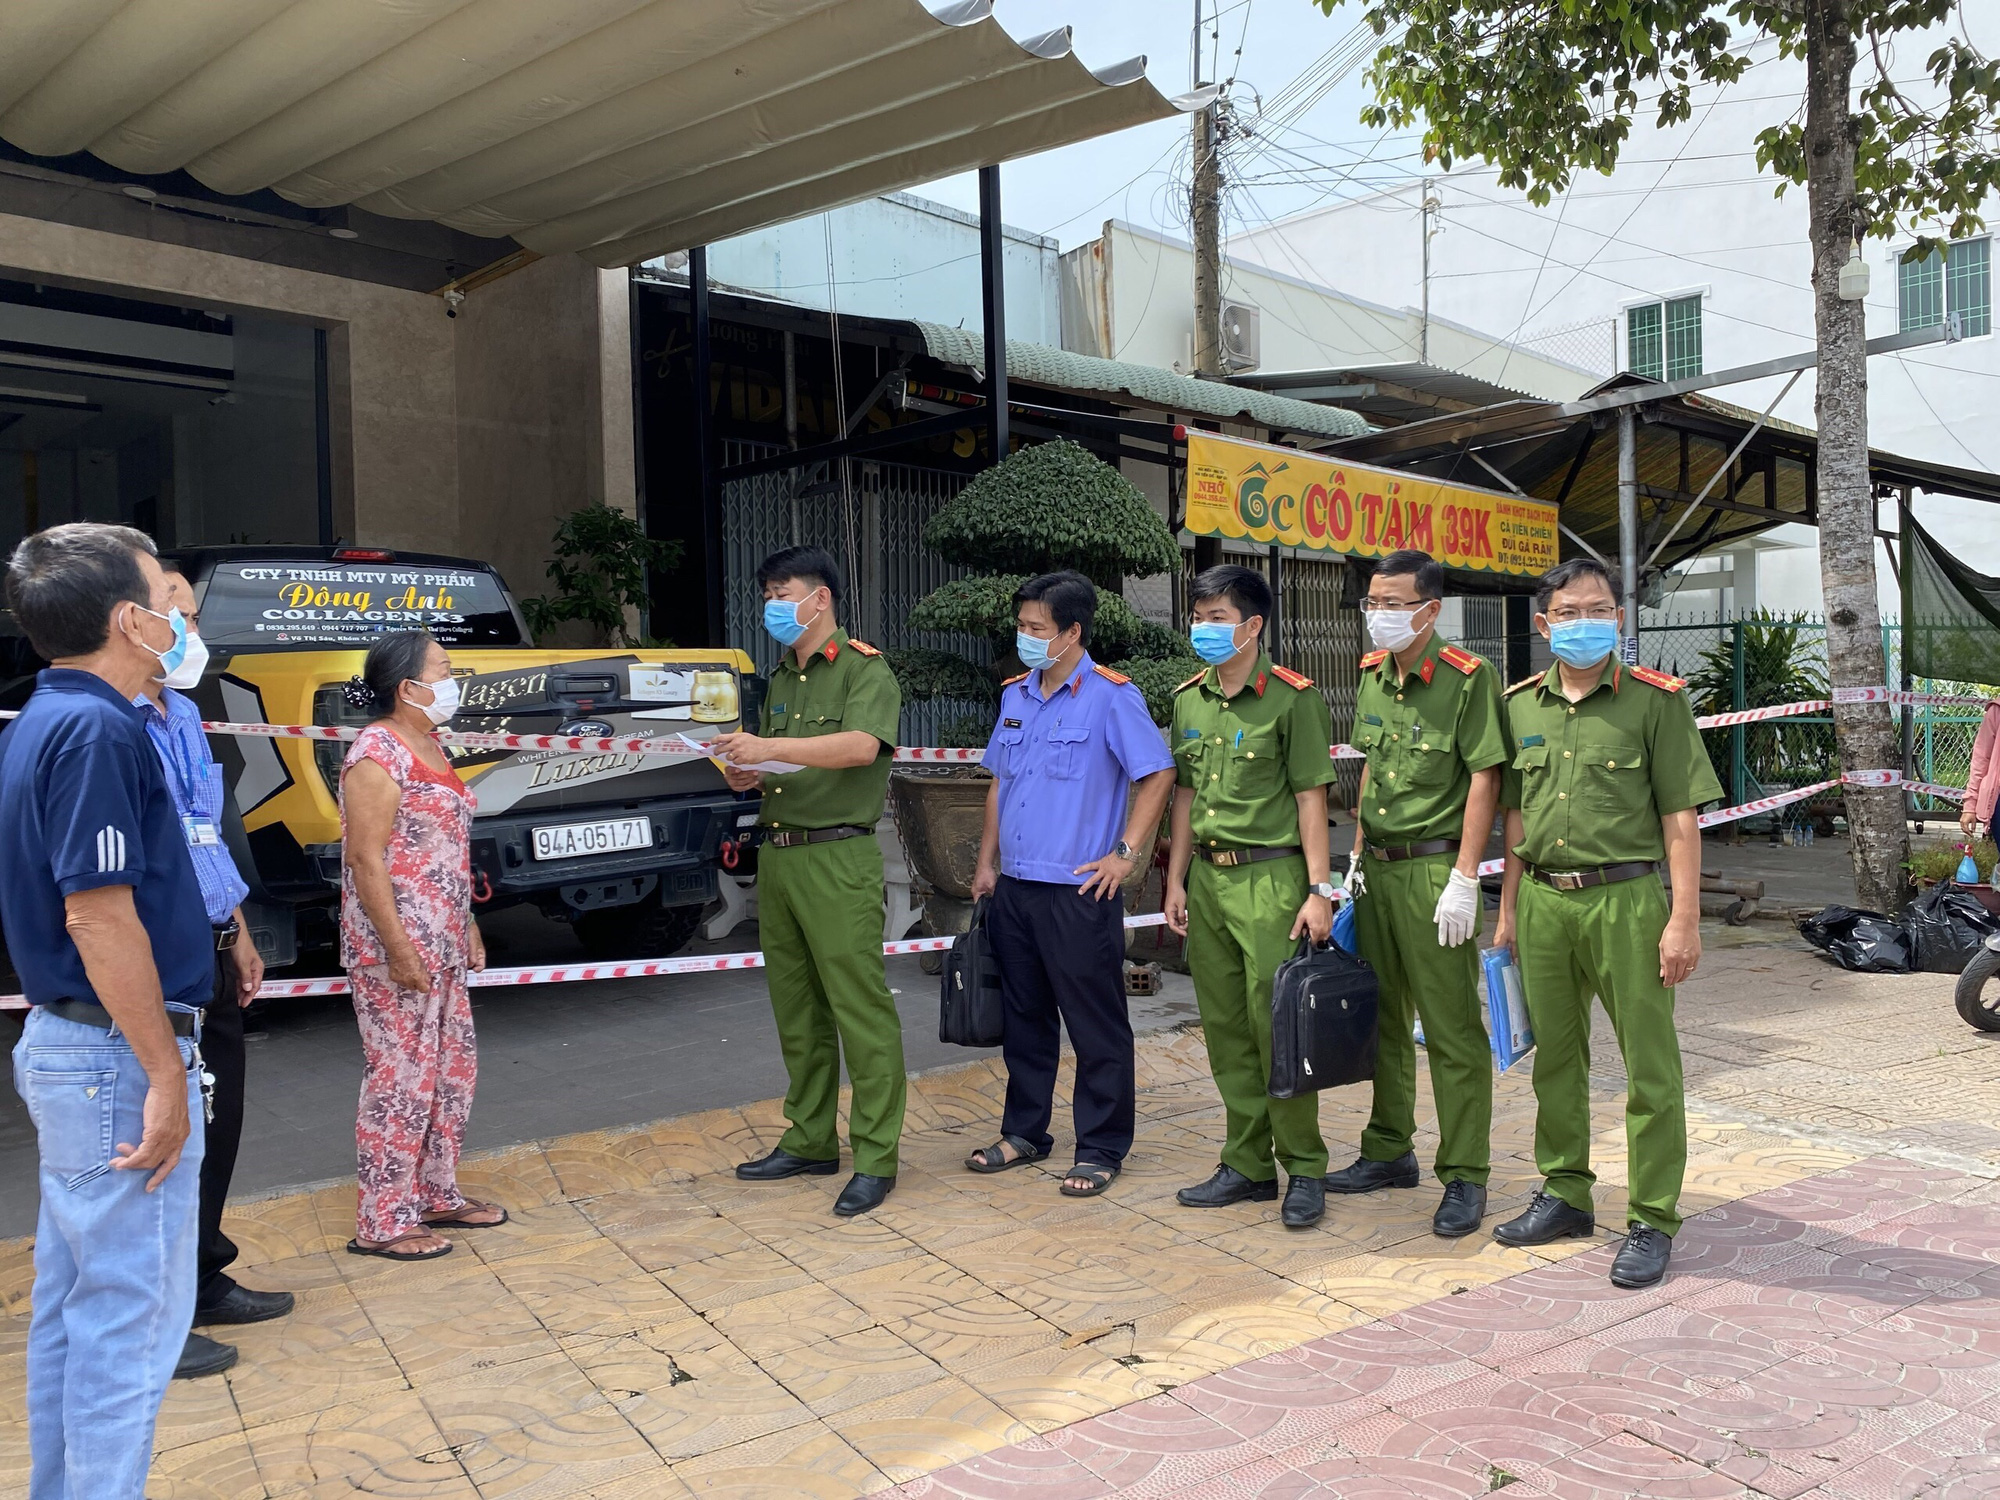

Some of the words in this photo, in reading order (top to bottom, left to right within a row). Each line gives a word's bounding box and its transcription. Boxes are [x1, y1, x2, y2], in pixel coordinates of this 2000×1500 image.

[1300, 470, 1353, 541] CÔ
[1441, 504, 1494, 559] 39K
[239, 568, 280, 580] CTY
[286, 569, 342, 582] TNHH
[346, 571, 387, 584] MTV
[390, 571, 423, 586] MỸ
[424, 570, 476, 587] PHẨM
[279, 582, 373, 612] Đông
[385, 586, 457, 611] Anh
[262, 609, 422, 623] COLLAGEN
[426, 611, 466, 624] X3
[266, 624, 316, 632] 0836.295.649
[663, 662, 737, 677] RAPTOR
[578, 725, 604, 737] Ford
[527, 753, 646, 789] Luxury
[538, 821, 644, 855] 94A-051.71
